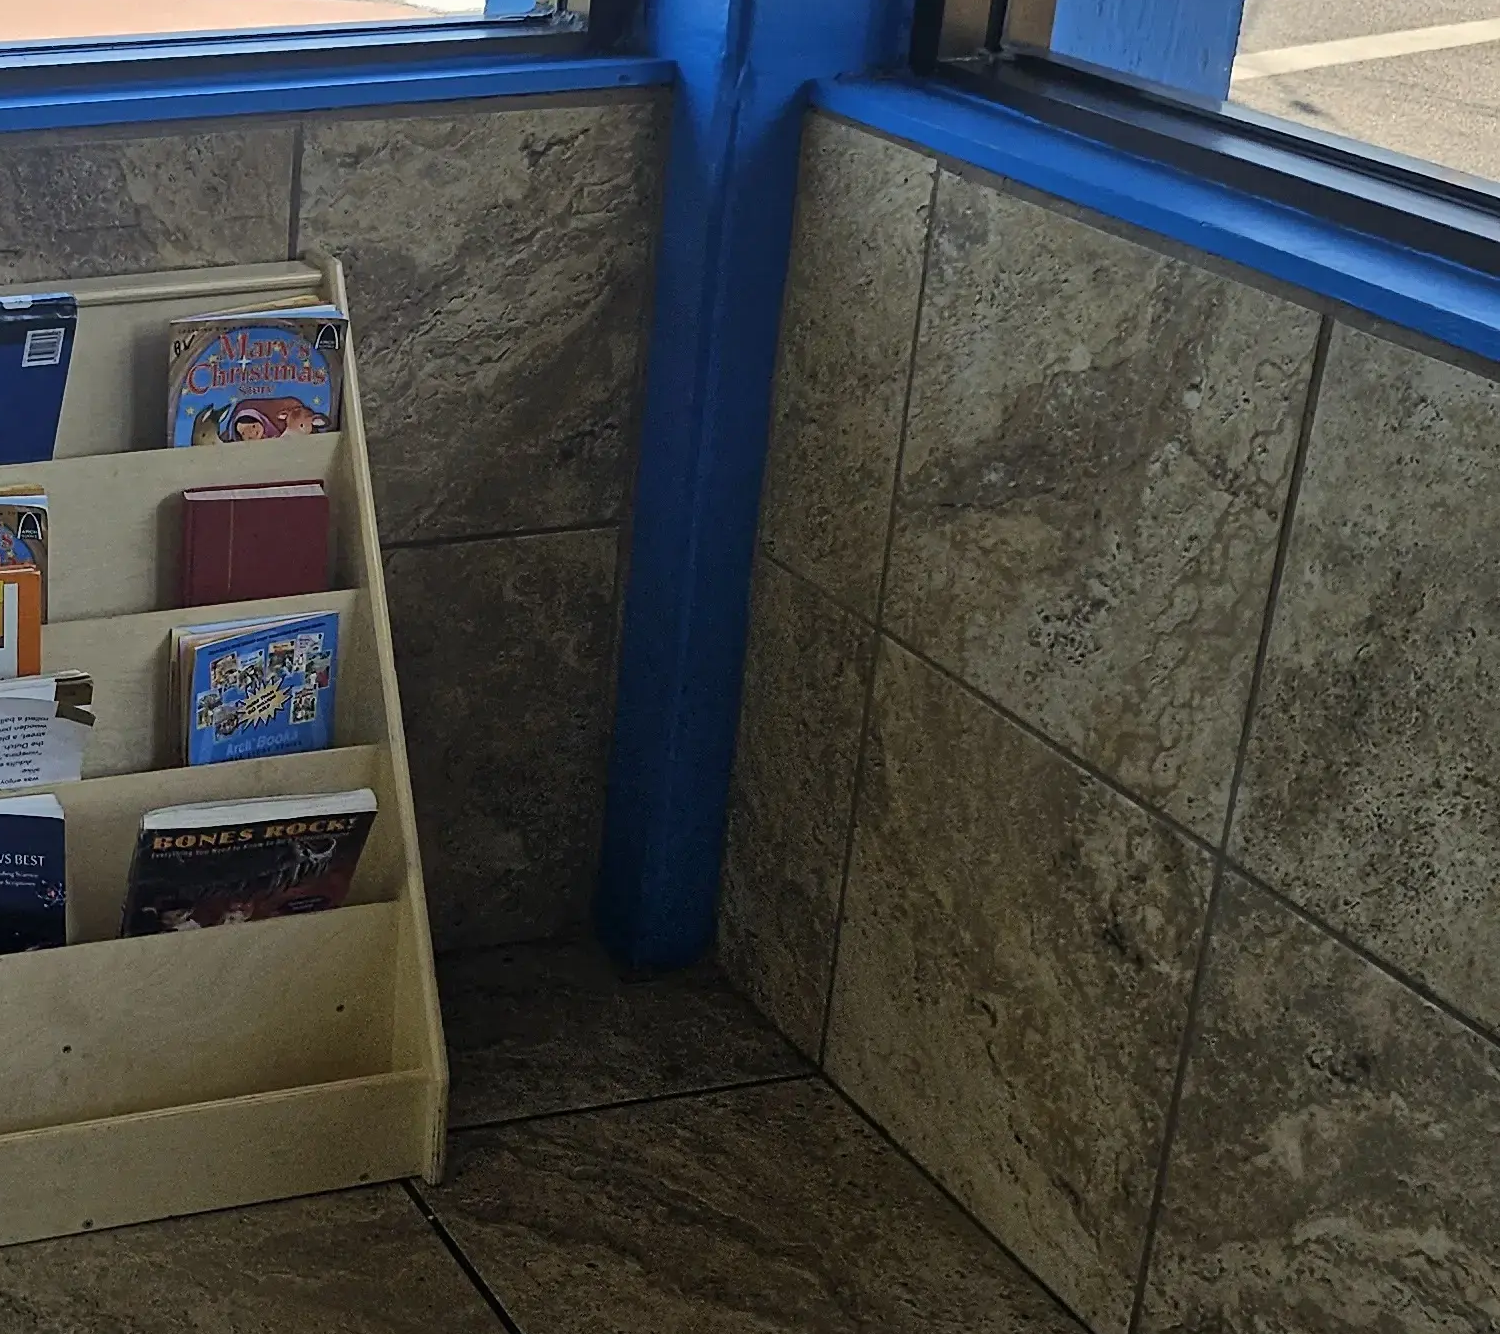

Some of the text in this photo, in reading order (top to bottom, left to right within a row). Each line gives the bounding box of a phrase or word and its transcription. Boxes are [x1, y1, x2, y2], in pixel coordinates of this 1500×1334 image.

[218, 332, 312, 363] Mary's
[186, 358, 327, 395] Christmas
[0, 717, 15, 726] ball
[256, 730, 298, 748] Books
[153, 828, 254, 850] BONES
[264, 816, 357, 838] ROCK!
[14, 854, 46, 867] BEST
